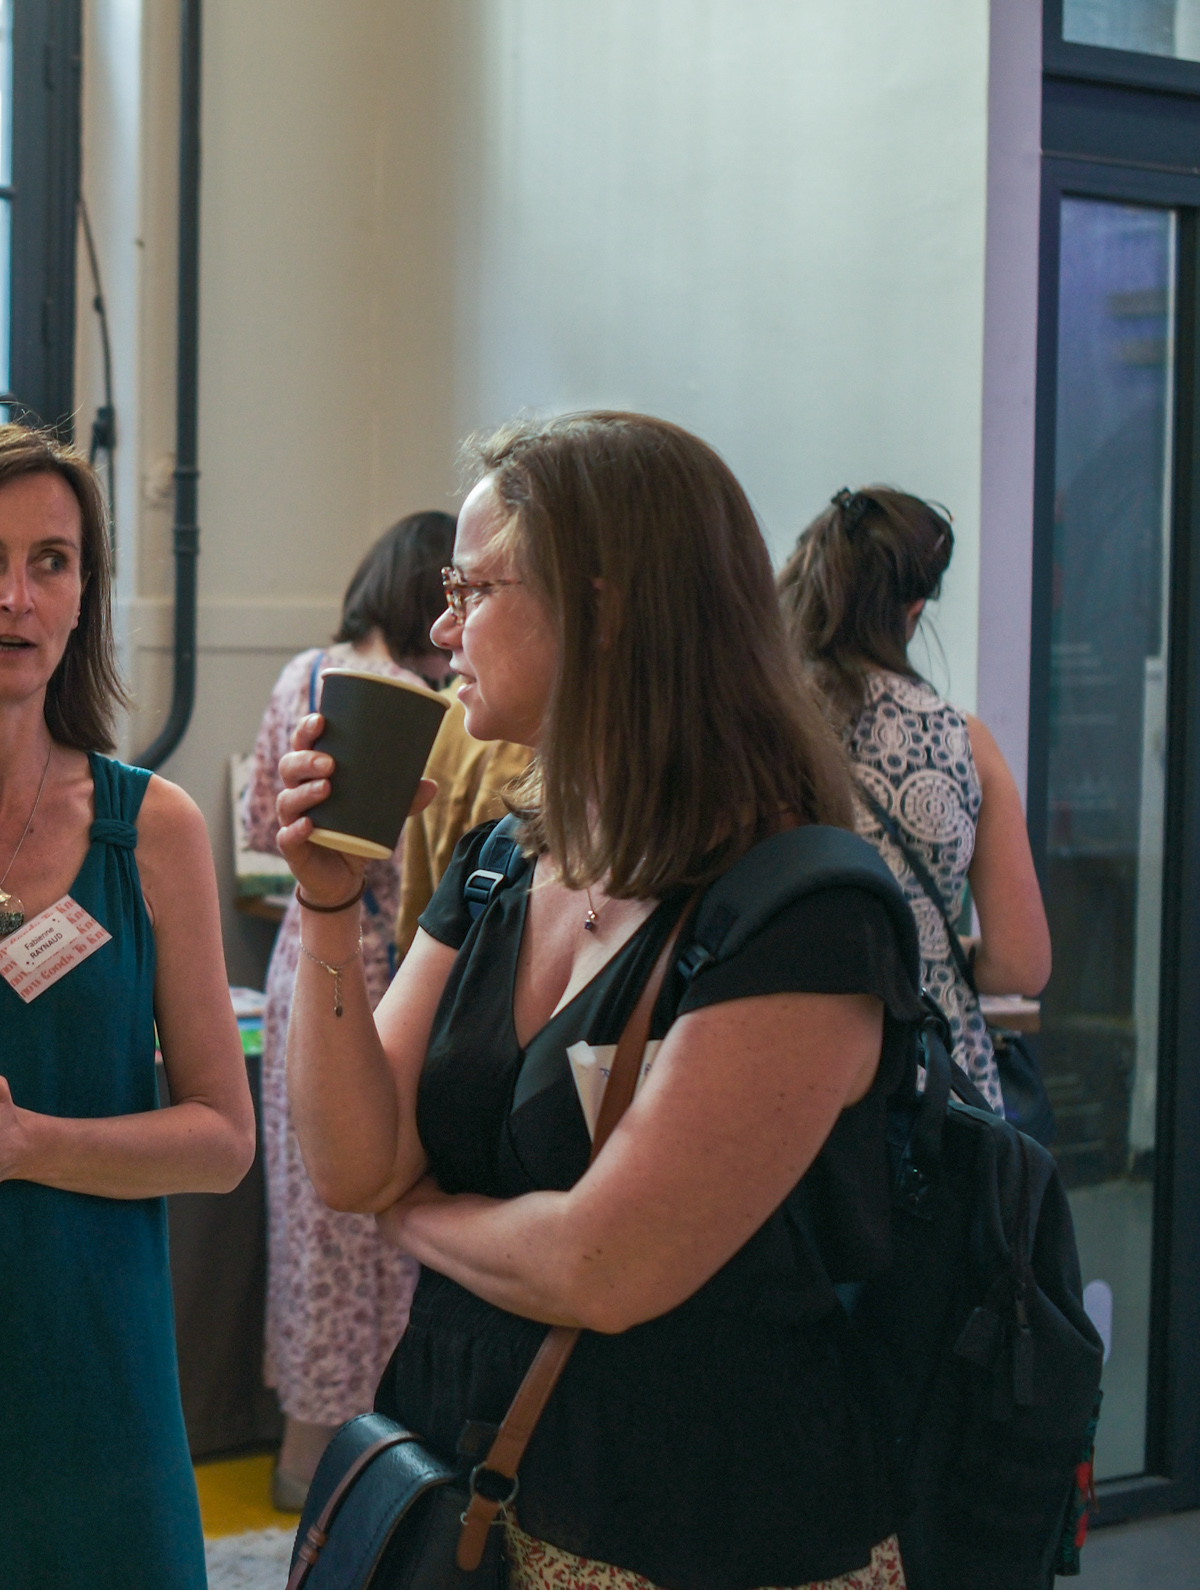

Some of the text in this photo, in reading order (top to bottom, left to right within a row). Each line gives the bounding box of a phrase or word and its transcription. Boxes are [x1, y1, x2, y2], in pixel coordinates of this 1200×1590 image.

[24, 926, 55, 951] Fabienne
[29, 932, 64, 959] RAYNAUD
[40, 954, 74, 980] Goods
[72, 943, 87, 955] To
